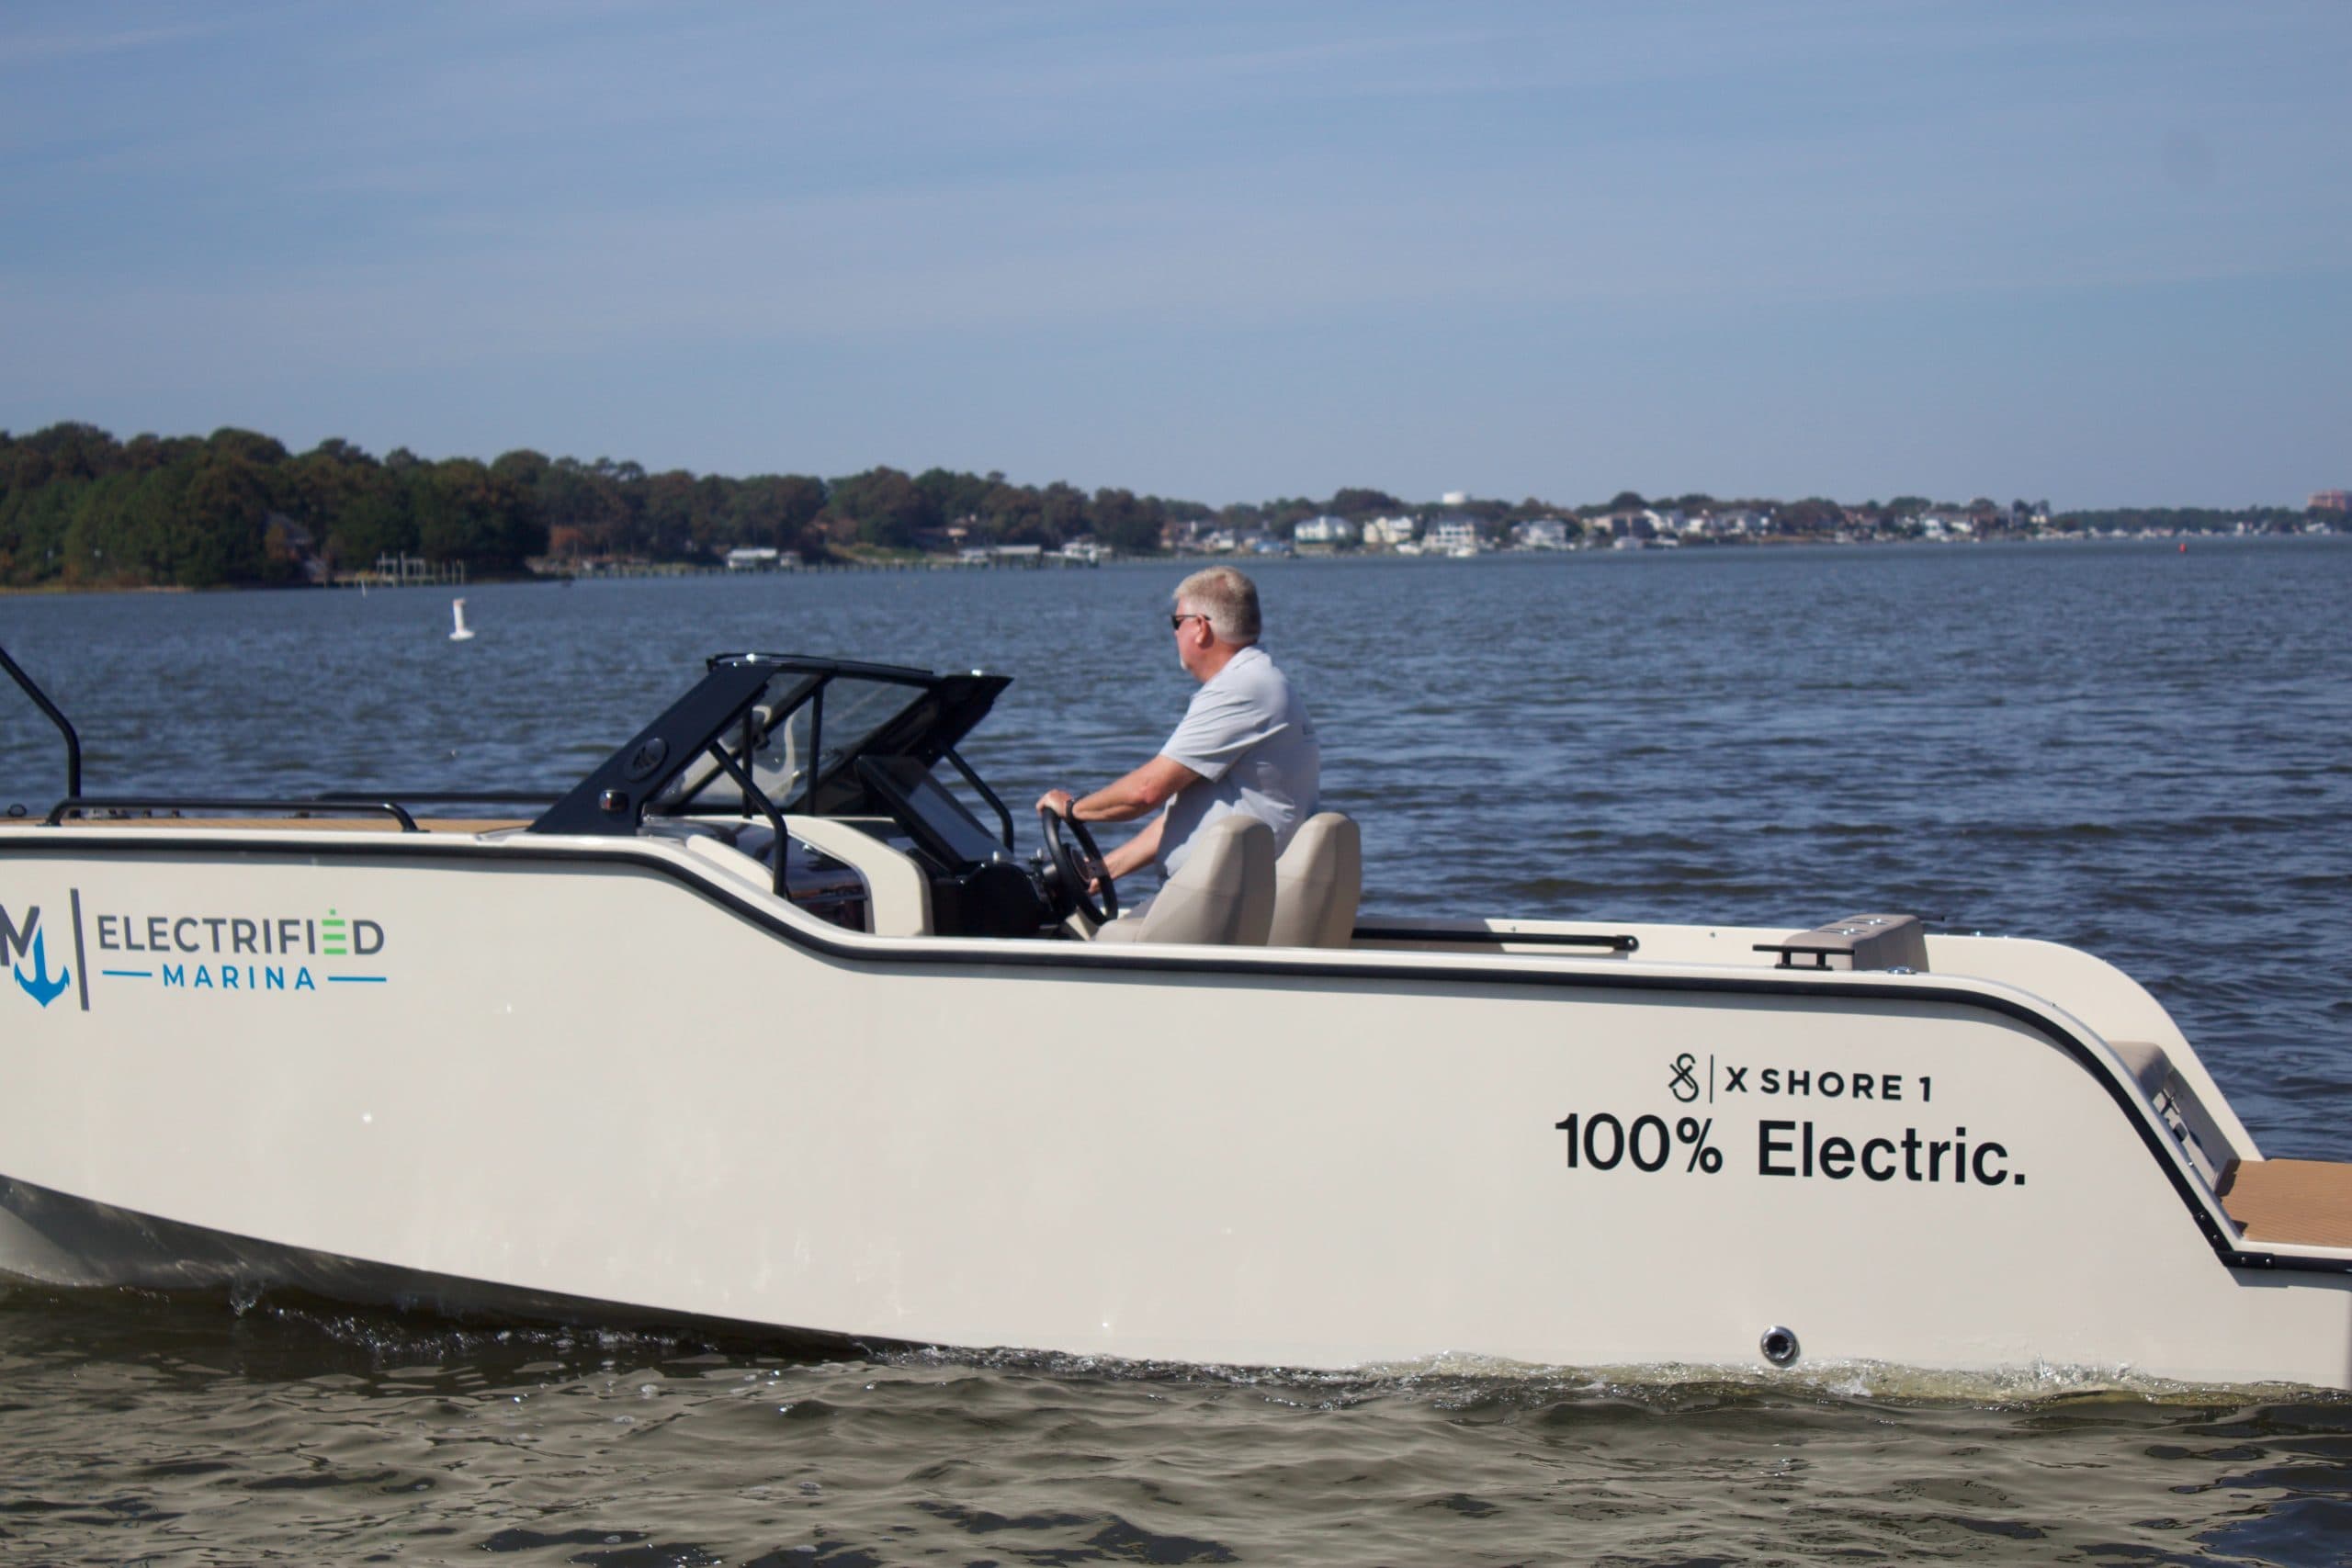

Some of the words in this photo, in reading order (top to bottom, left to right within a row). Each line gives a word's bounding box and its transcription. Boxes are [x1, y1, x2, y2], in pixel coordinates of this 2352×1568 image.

[96, 908, 385, 955] ELECTRIFIED
[162, 964, 316, 991] MARINA
[1724, 1066, 1749, 1094] X
[1759, 1067, 1903, 1101] SHORE
[1918, 1076, 1931, 1103] 1
[1555, 1111, 1724, 1175] 100%
[1758, 1119, 2026, 1187] Electric.
